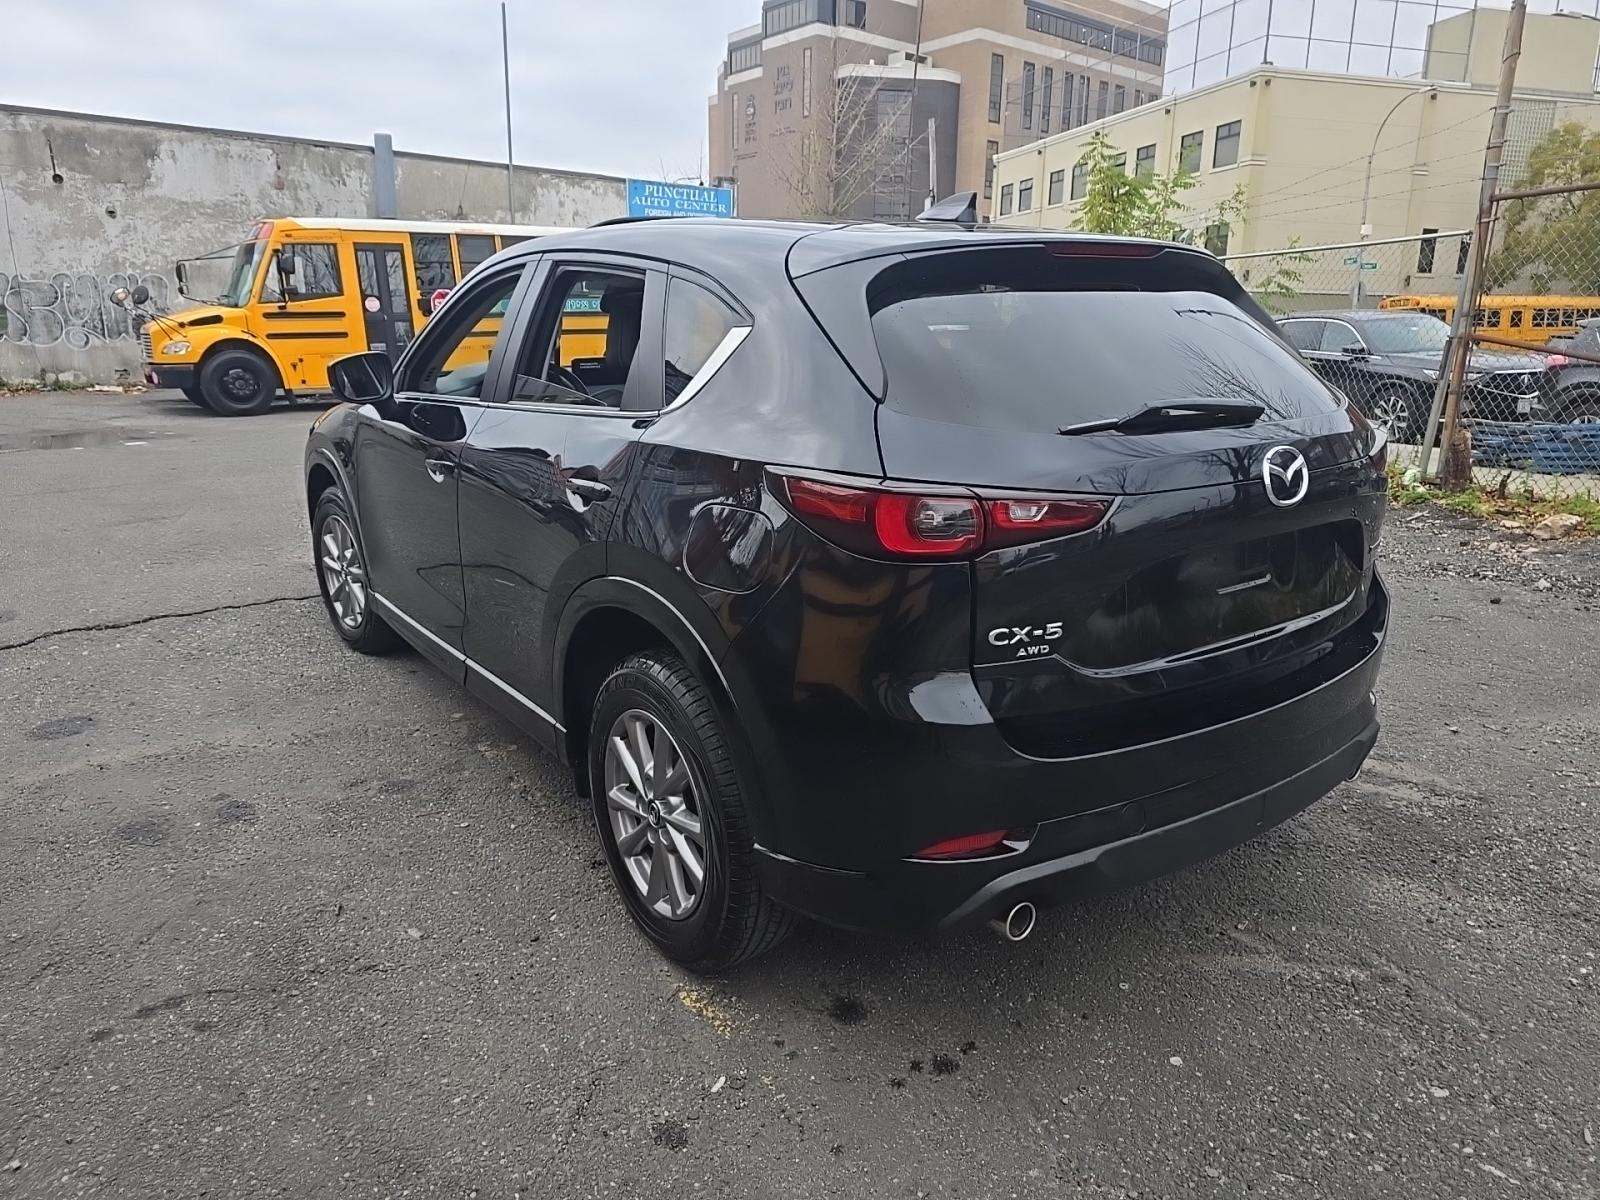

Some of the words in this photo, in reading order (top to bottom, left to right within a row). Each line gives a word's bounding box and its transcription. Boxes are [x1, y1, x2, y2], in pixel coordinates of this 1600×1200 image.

[644, 184, 718, 203] PUNCTUAL
[632, 196, 670, 207] AUTO
[675, 199, 728, 213] CENTER
[988, 622, 1063, 646] CX-5
[1016, 645, 1050, 657] AWD
